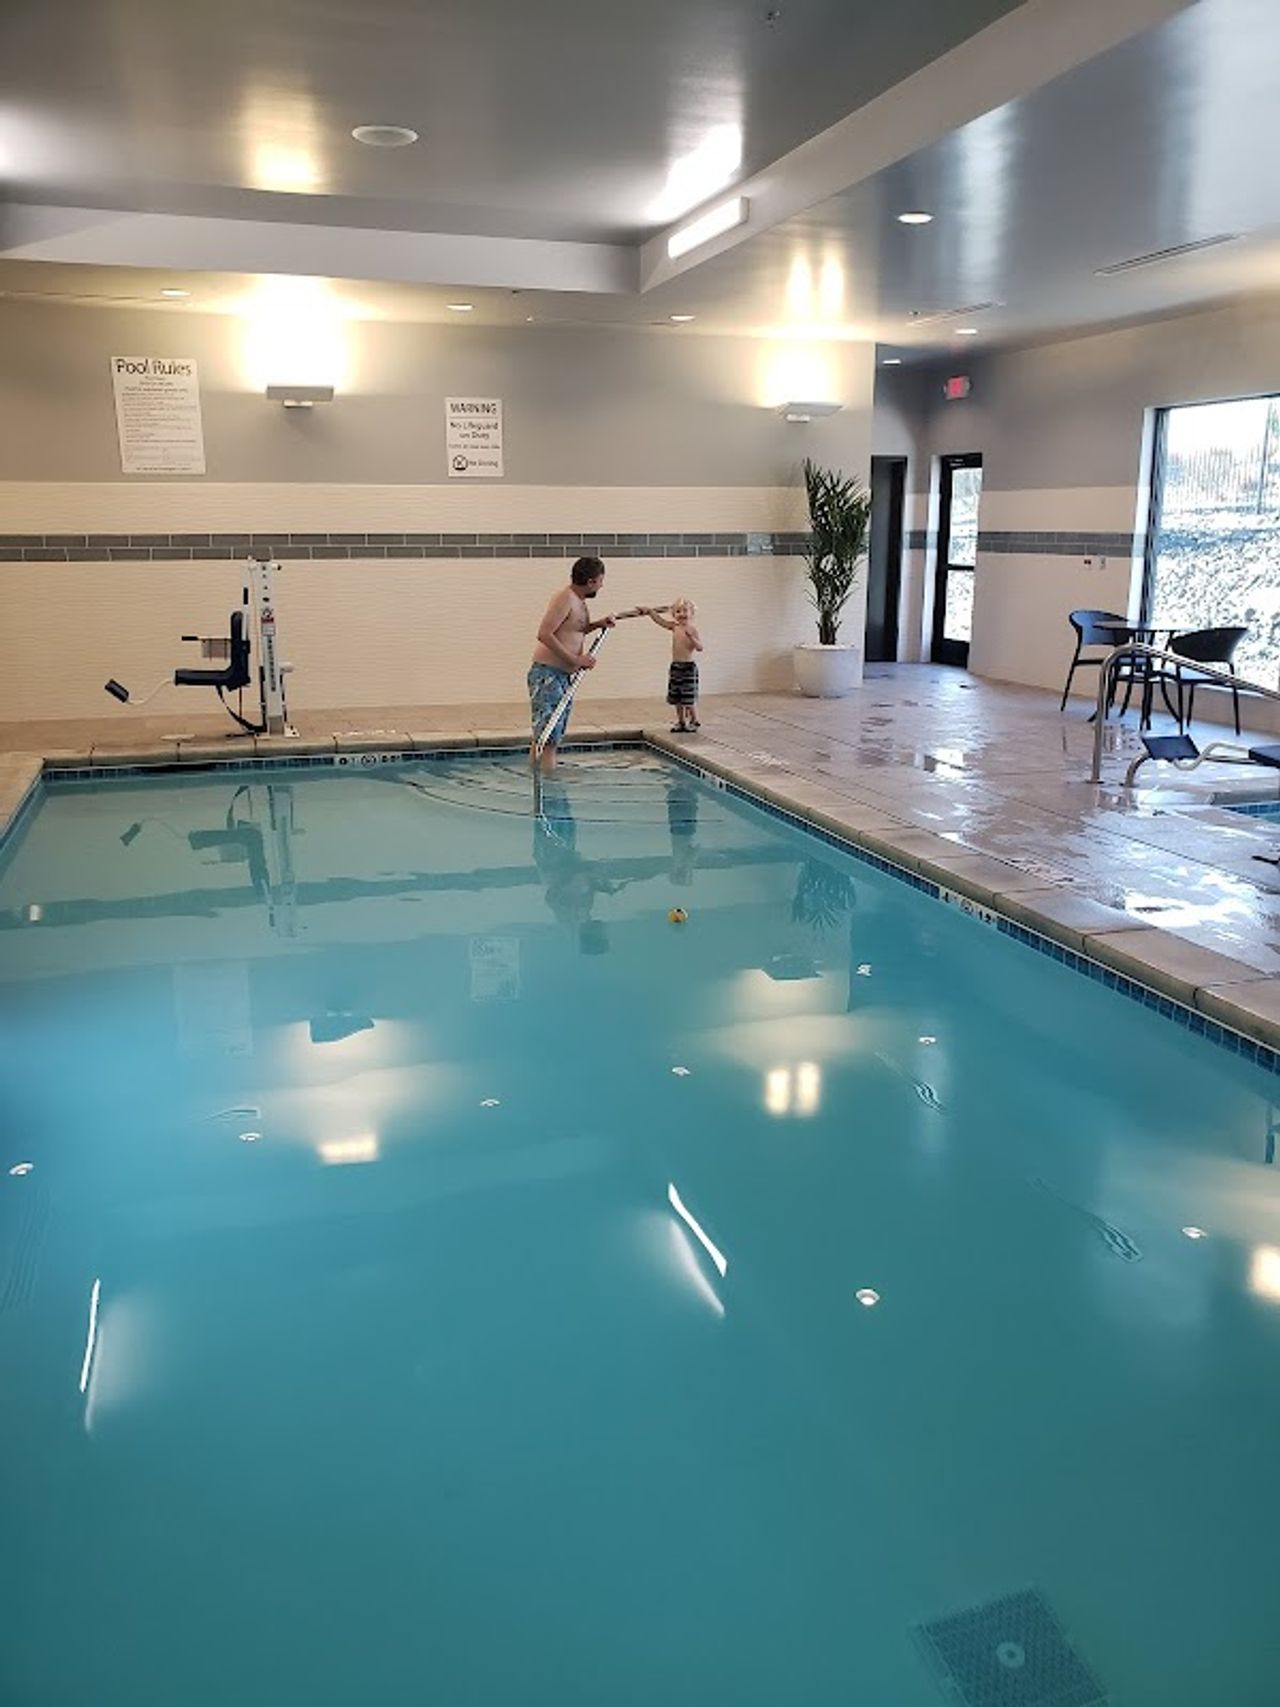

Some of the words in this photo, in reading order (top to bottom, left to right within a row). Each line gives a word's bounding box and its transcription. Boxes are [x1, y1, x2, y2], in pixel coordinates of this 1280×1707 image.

[115, 358, 149, 375] Pool
[152, 360, 192, 376] Rules
[450, 403, 497, 414] WARNING
[463, 421, 498, 430] Lifeguard
